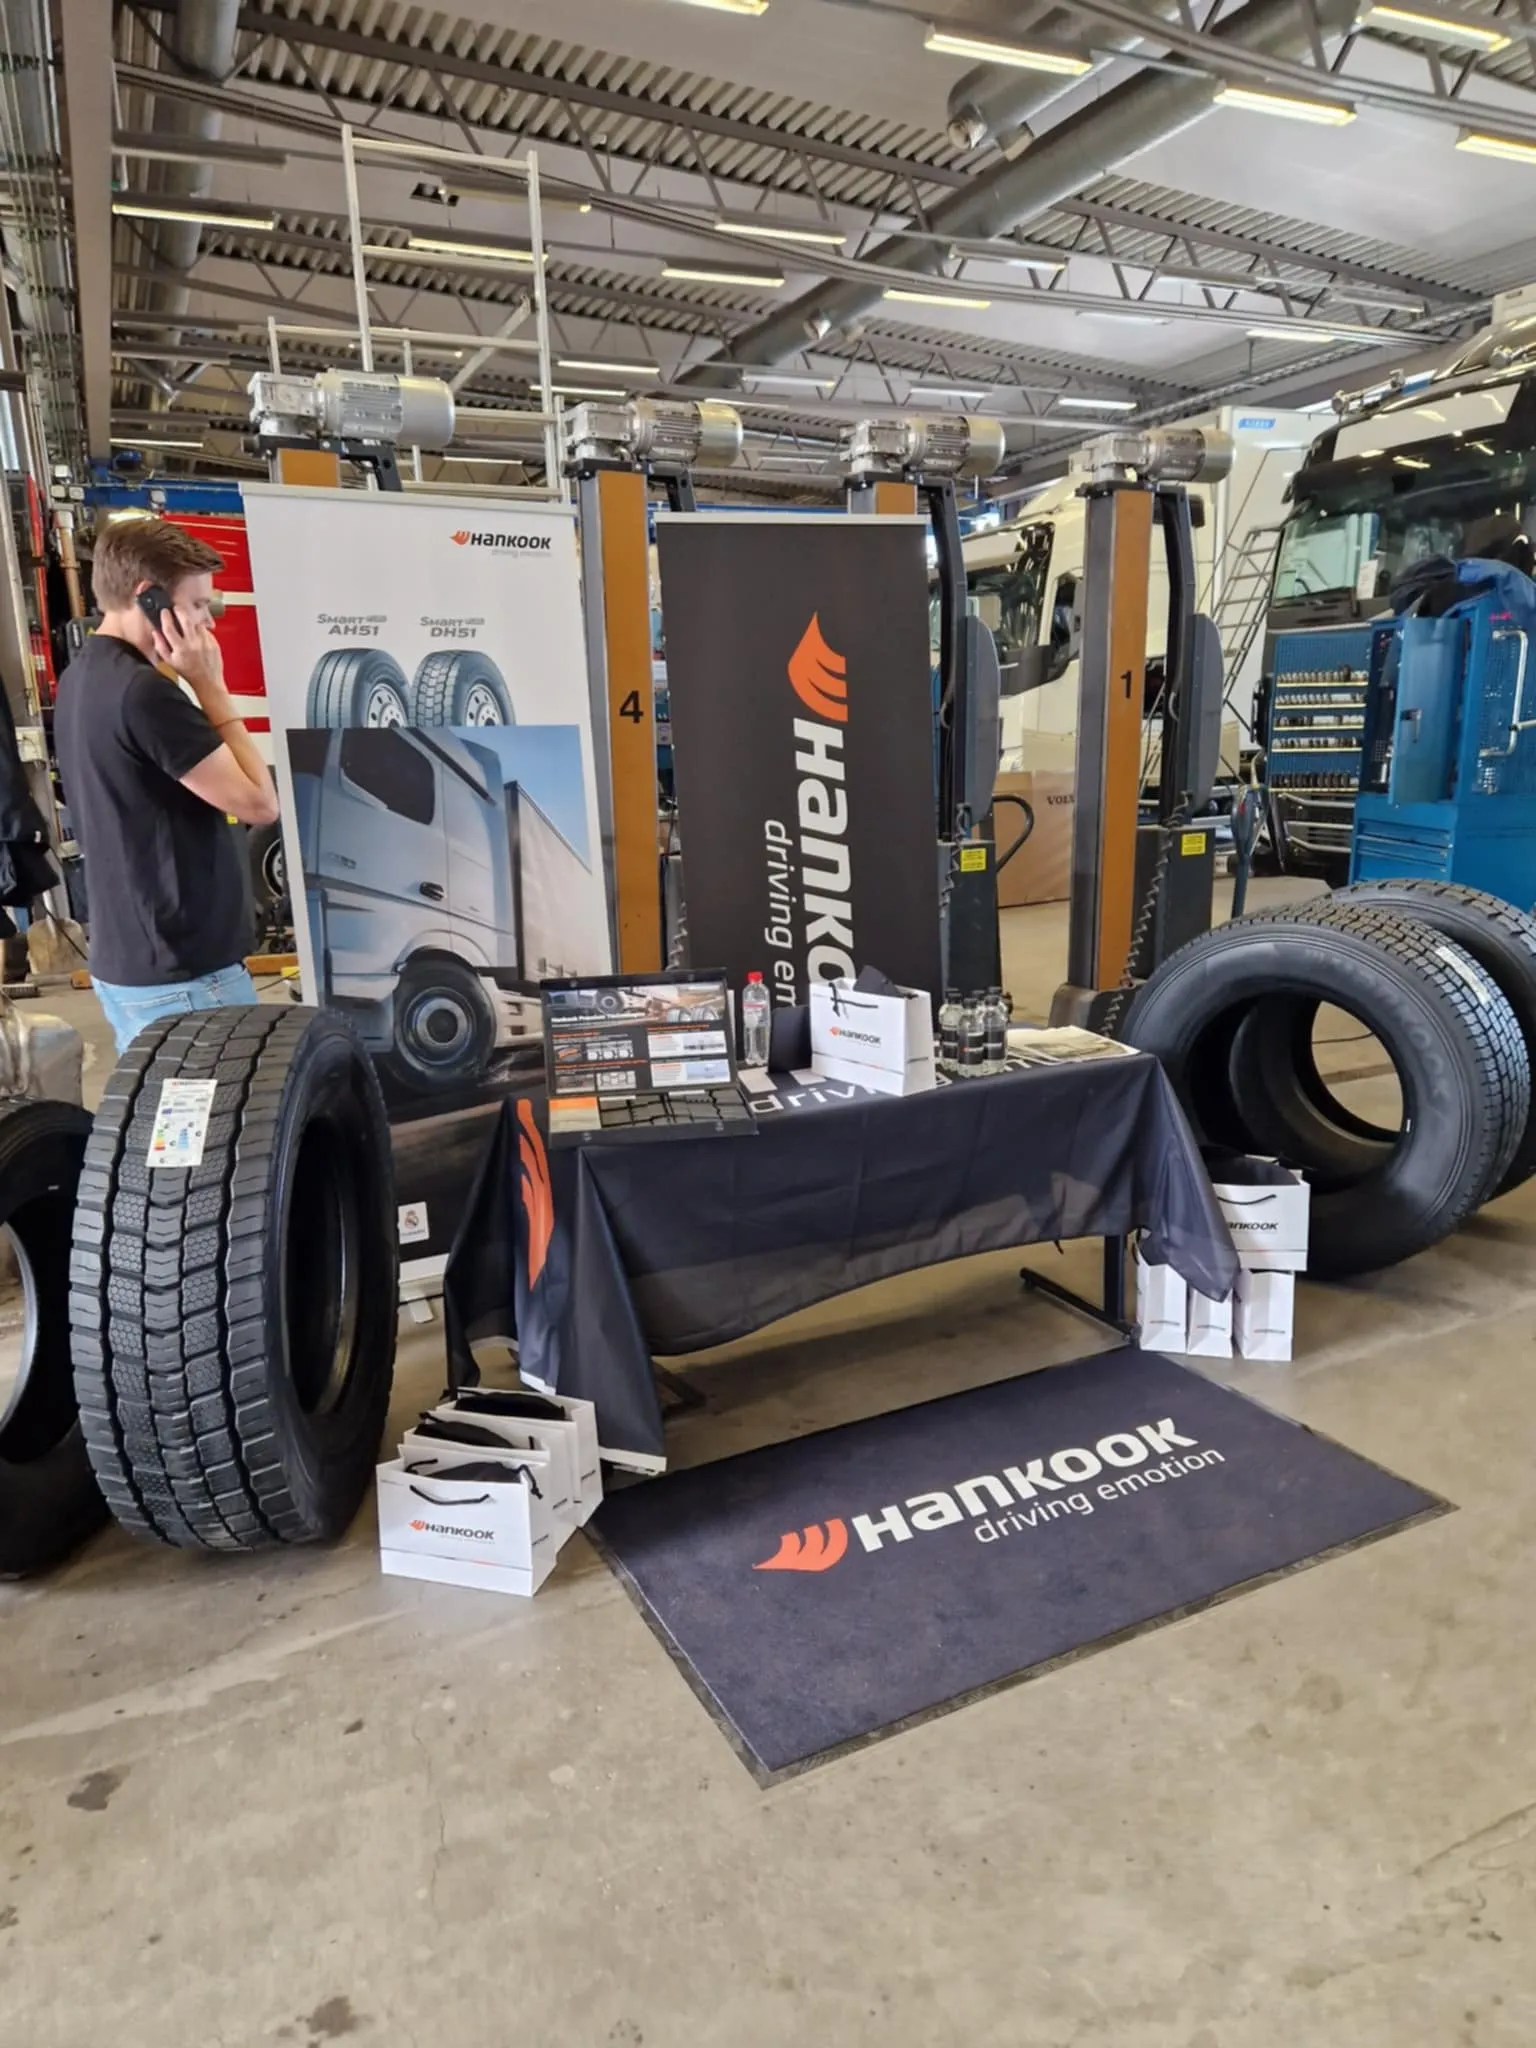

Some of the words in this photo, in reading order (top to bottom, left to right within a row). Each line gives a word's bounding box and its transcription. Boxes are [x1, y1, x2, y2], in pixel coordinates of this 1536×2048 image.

[619, 690, 644, 724] 4
[1120, 670, 1132, 699] 1
[764, 819, 798, 950] driving
[974, 1491, 1094, 1544] driving
[1097, 1446, 1226, 1501] emotion
